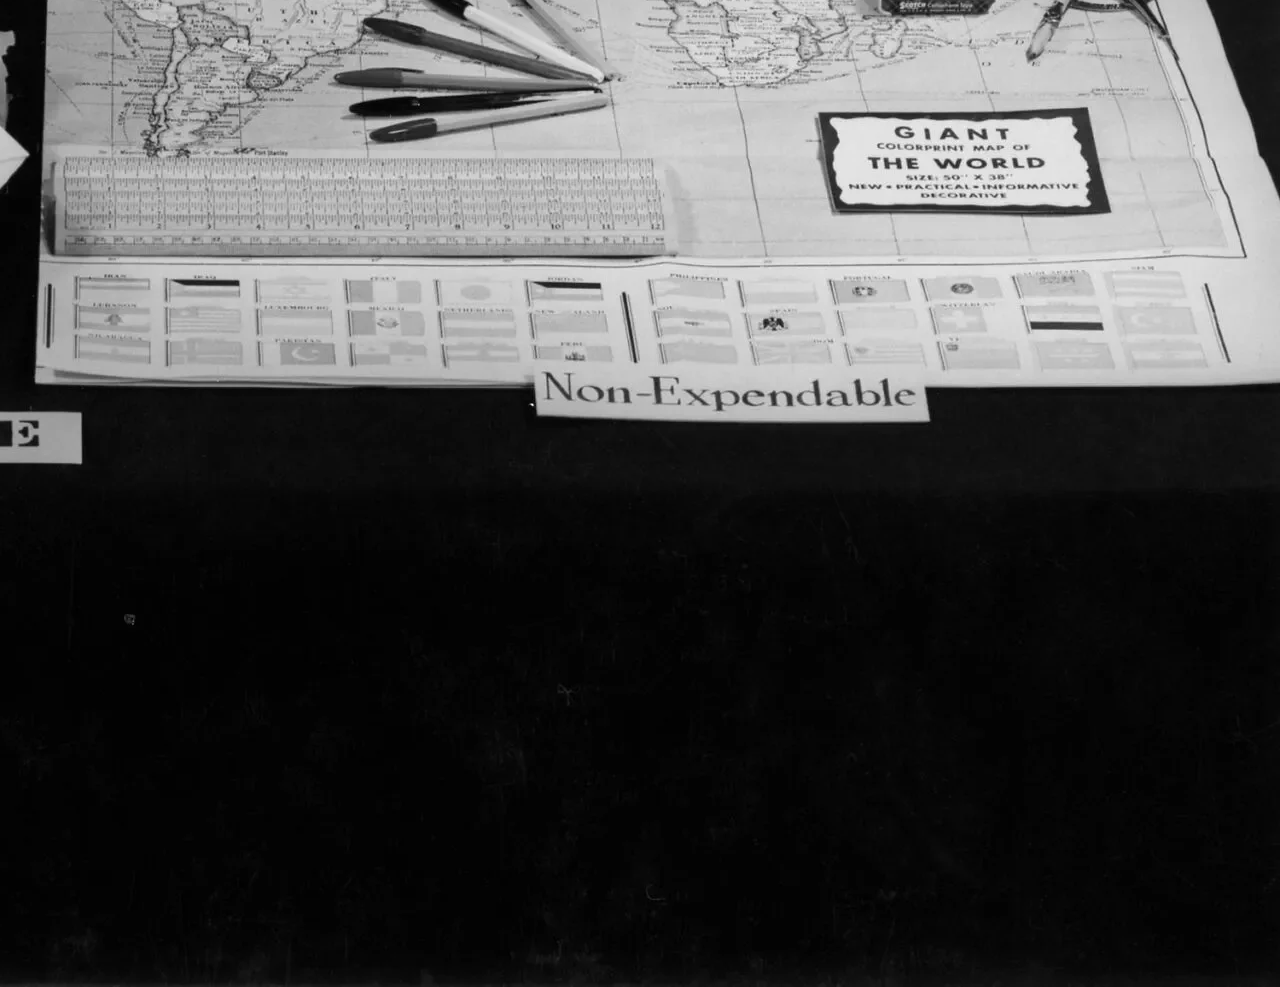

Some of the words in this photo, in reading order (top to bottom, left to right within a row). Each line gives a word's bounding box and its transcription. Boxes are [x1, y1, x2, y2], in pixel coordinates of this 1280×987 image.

[894, 126, 1010, 141] GIANT
[876, 142, 965, 152] COLORPRINT
[972, 144, 1005, 152] MAP
[1012, 144, 1031, 152] OF
[868, 156, 920, 170] THE
[933, 156, 1046, 170] WORLD
[906, 174, 939, 182] SIZE:
[920, 192, 1008, 200] DECORATIVE
[541, 371, 918, 412] Non-Expendable
